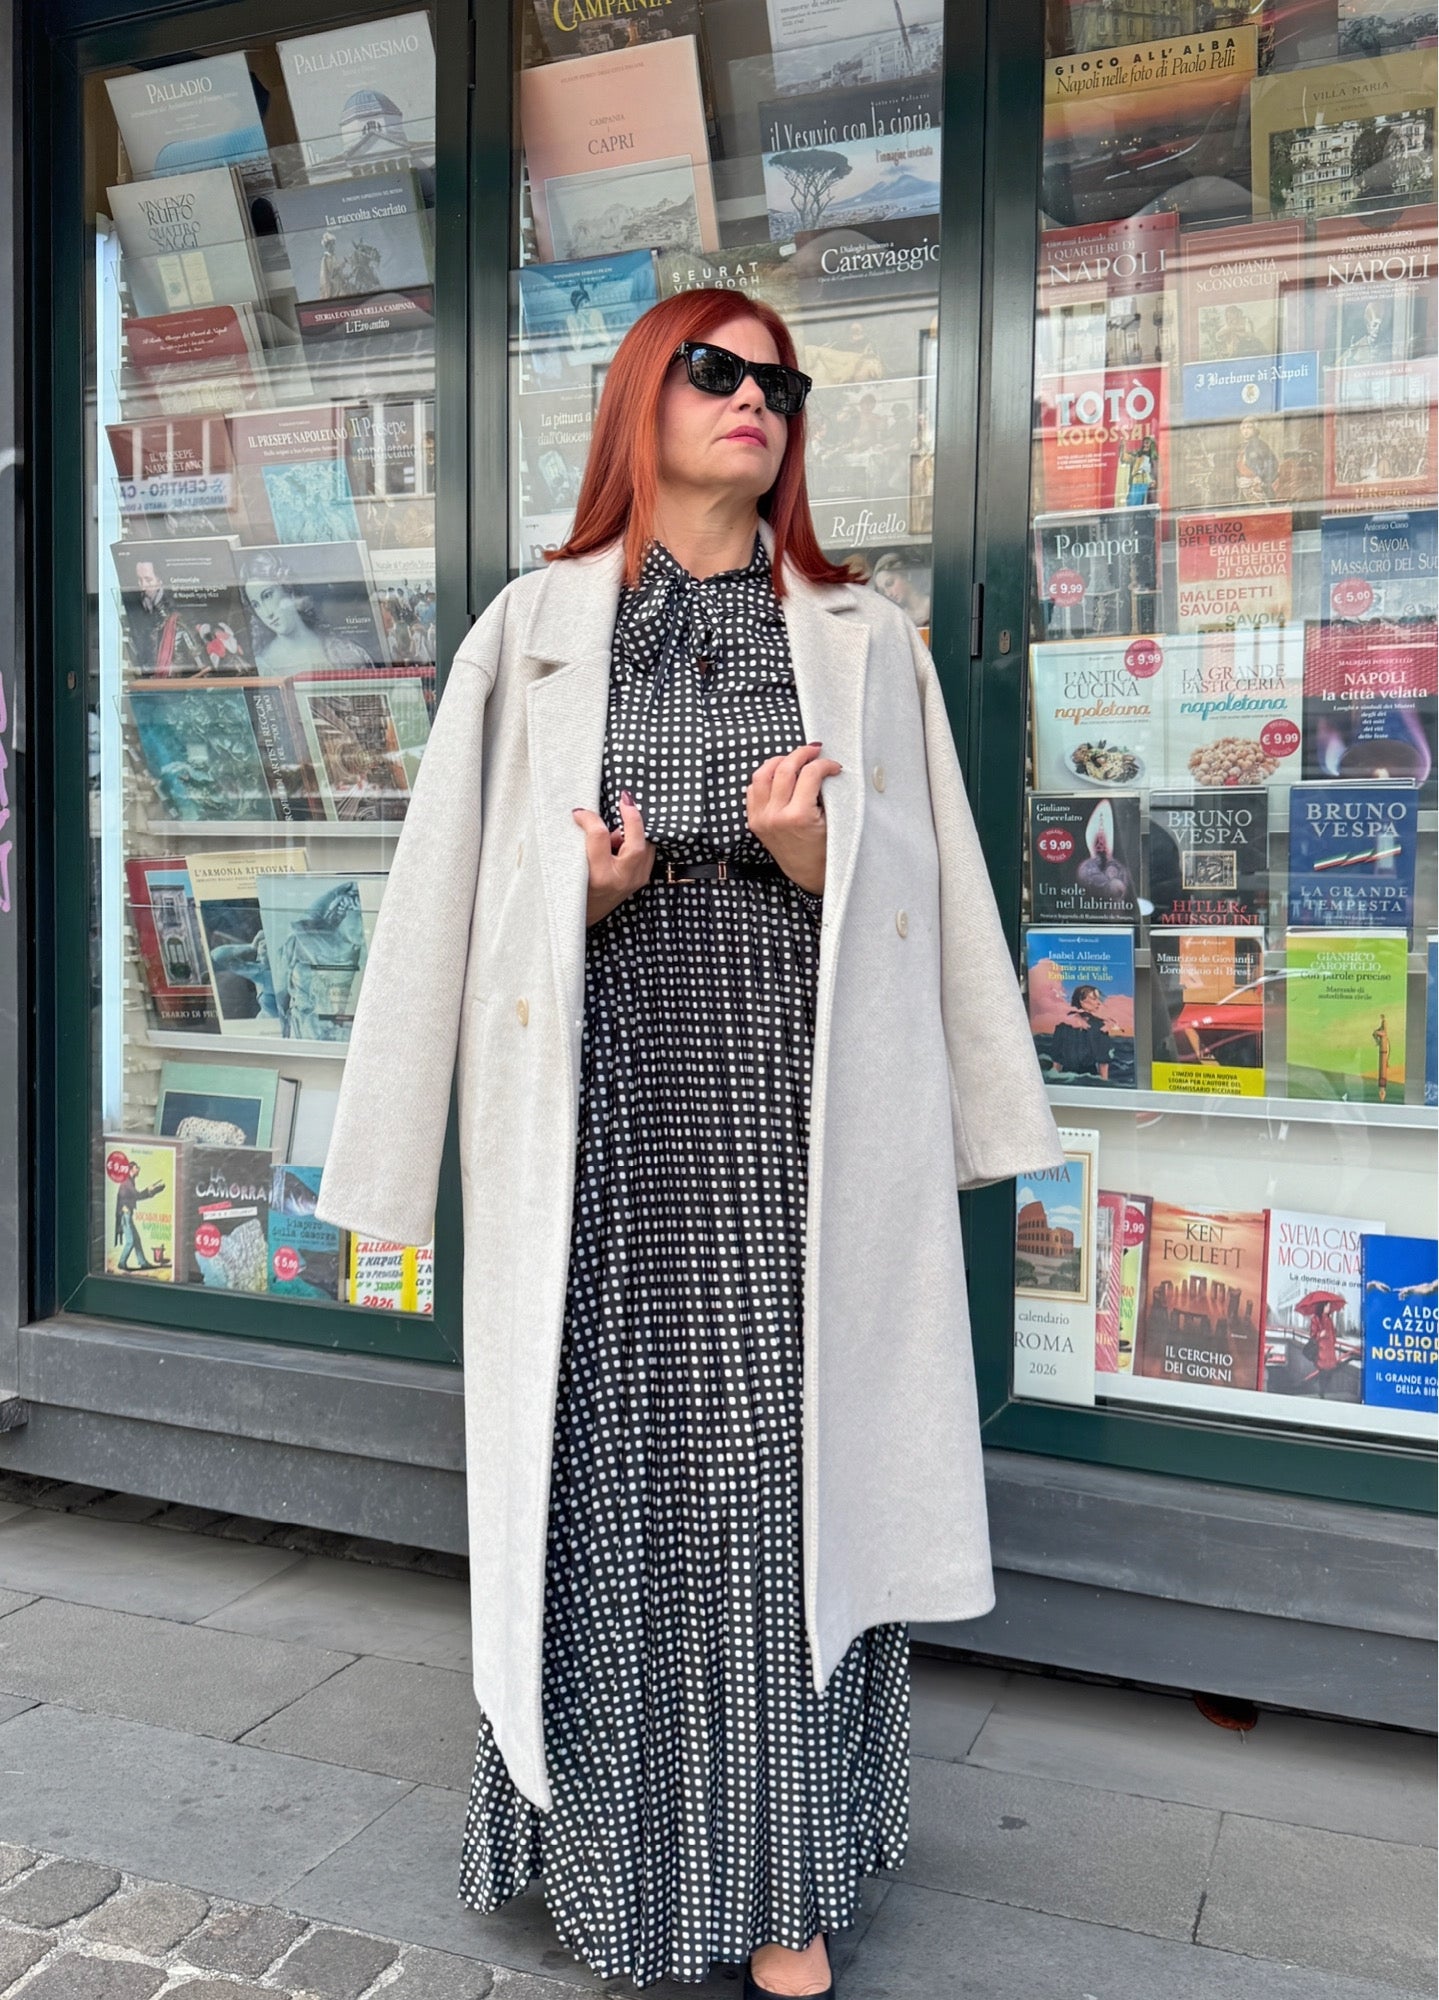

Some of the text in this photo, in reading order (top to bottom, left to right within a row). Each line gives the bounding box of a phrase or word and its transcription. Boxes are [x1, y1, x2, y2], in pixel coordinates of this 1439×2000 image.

[553, 0, 672, 32] CAMPAN
[293, 34, 419, 75] PALLADIANESIMO
[1054, 38, 1236, 76] GIOCO ALL' ALBA
[1056, 48, 1236, 95] Napoli nelle foto di Paolo Pelli
[145, 76, 213, 104] PALLADIO
[1312, 82, 1389, 101] VILLA MARIA
[588, 114, 626, 126] CAMPANIA
[770, 105, 932, 152] il Vesuvio con la cipria
[588, 132, 635, 156] CAPRI
[138, 193, 196, 212] VINCENZO
[325, 214, 336, 226] La
[337, 208, 372, 224] raccolta
[1054, 244, 1119, 261] QUARTIERI
[1122, 240, 1136, 251] DI
[672, 262, 758, 283] SEURAT
[1048, 248, 1168, 287] NAPOLI
[1208, 258, 1276, 278] CAMPANIA
[1326, 254, 1430, 287] NAPOLI
[714, 276, 760, 290] GOGH
[1196, 270, 1290, 293] SCONOSCIUTA
[1206, 371, 1256, 390] Borbone
[1258, 369, 1268, 382] di
[1270, 364, 1308, 384] Napoli
[1055, 378, 1155, 426] TOTÒ
[350, 417, 360, 438] Il
[1056, 422, 1155, 447] KOLOSSAL
[248, 428, 348, 448] IL PRESEPE NAPOLETANO
[830, 508, 906, 548] Raffaello
[1178, 522, 1243, 537] LORENZO
[1364, 522, 1388, 532] Antonio
[1054, 530, 1140, 565] Pompei
[1180, 532, 1246, 548] DEL BOCA
[1210, 540, 1286, 557] EMANUELE
[1218, 552, 1286, 568] FILIBERTO
[1394, 558, 1414, 572] DEL
[1216, 564, 1286, 579] DI SAVOIA
[1049, 584, 1057, 594] €
[1180, 586, 1273, 604] MALEDETTI
[1180, 601, 1240, 617] SAVOIA
[1225, 612, 1286, 627] SAVOIA
[1126, 654, 1160, 666] € 9,99
[1182, 664, 1286, 681] LA GRANDE
[1344, 670, 1406, 686] NAPOLI
[1064, 682, 1140, 700] CUCINA
[1182, 678, 1286, 694] PASTICCERIA
[1322, 686, 1428, 701] la città velata
[1054, 699, 1151, 726] napoletana
[1180, 692, 1288, 721] napoletana
[1262, 732, 1298, 745] € 9,99
[1036, 804, 1070, 812] Giuliano
[1306, 802, 1407, 820] BRUNO
[1036, 813, 1083, 823] Capecelatro
[1168, 810, 1252, 828] BRUNO
[1172, 828, 1248, 844] VESPA
[1312, 822, 1400, 838] VESPA
[1040, 840, 1072, 852] € 9,99
[194, 864, 295, 878] L'ARMONIA RITROVATA
[1039, 882, 1086, 896] Un sole
[1300, 886, 1408, 898] LA GRANDE
[1056, 896, 1134, 910] nel labirinto
[1172, 900, 1240, 913] HITLER
[1306, 900, 1403, 912] TEMPESTA
[1162, 914, 1260, 926] MUSSOLINI
[1048, 950, 1111, 961] Isabel Allende
[1156, 952, 1254, 964] Maurizio de Giovanni
[1316, 952, 1375, 962] GIANRICO
[1310, 961, 1382, 972] CAROFIGLIO
[1048, 972, 1114, 982] Emilia del Valle
[1322, 971, 1355, 982] parole
[1356, 972, 1392, 982] precise
[161, 1010, 190, 1020] DIARIO
[1168, 1084, 1210, 1092] COMMISSARIO
[1024, 1166, 1070, 1183] ROMA
[196, 1182, 268, 1201] CAMORRA
[1122, 1220, 1145, 1234] 9,99
[1186, 1223, 1224, 1244] KEN
[1280, 1222, 1320, 1248] SVEVA
[1162, 1239, 1246, 1268] FOLLETT
[1278, 1245, 1362, 1275] MODIGNA
[1018, 1310, 1070, 1326] calendario
[1382, 1316, 1438, 1334] CAZZU
[1014, 1331, 1074, 1354] ROMA
[1389, 1333, 1432, 1350] IL DIO
[1165, 1345, 1233, 1366] IL CERCHIO
[1372, 1346, 1427, 1364] NOSTRI
[1029, 1362, 1057, 1376] 2026
[1164, 1360, 1232, 1382] DEI GIORNI
[1376, 1372, 1382, 1382] IL
[1384, 1372, 1422, 1384] GRANDE
[1396, 1384, 1422, 1396] DELLA
